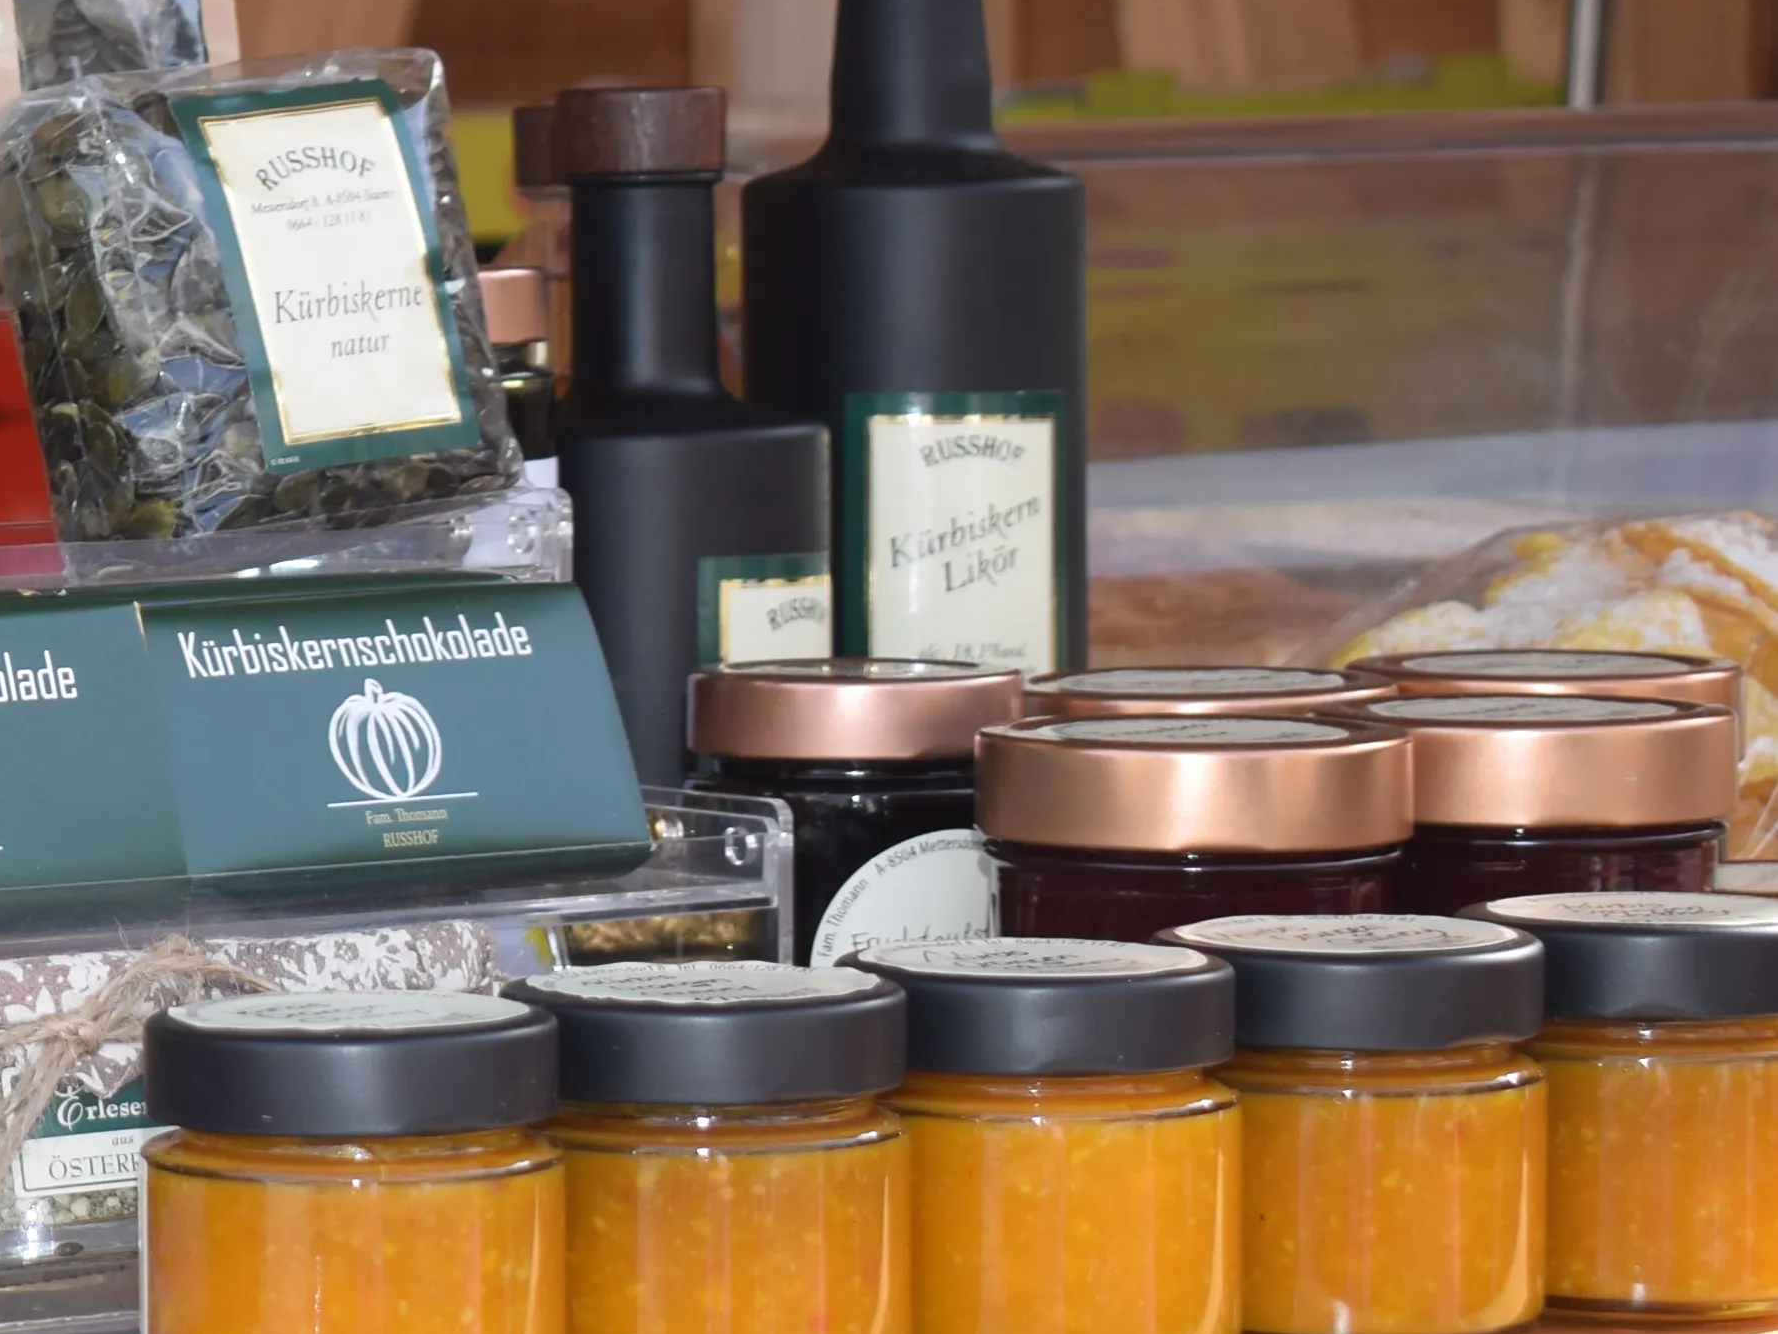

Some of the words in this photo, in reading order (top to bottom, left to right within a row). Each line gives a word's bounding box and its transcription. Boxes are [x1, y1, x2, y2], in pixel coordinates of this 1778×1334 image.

[256, 145, 376, 191] RUSSHOF
[273, 280, 424, 325] Kürbiskerne
[330, 332, 392, 361] natur
[889, 496, 1041, 569] Kürbiskern
[943, 544, 1021, 593] Likör
[177, 611, 533, 679] Kürbiskernschokolade
[364, 810, 394, 825] Fam.
[394, 807, 449, 823] Thomann
[382, 828, 440, 848] RUSSHOF
[825, 878, 870, 927] Thomann
[874, 845, 918, 876] A-8504
[54, 1085, 147, 1131] Erlese
[111, 1135, 135, 1146] aus
